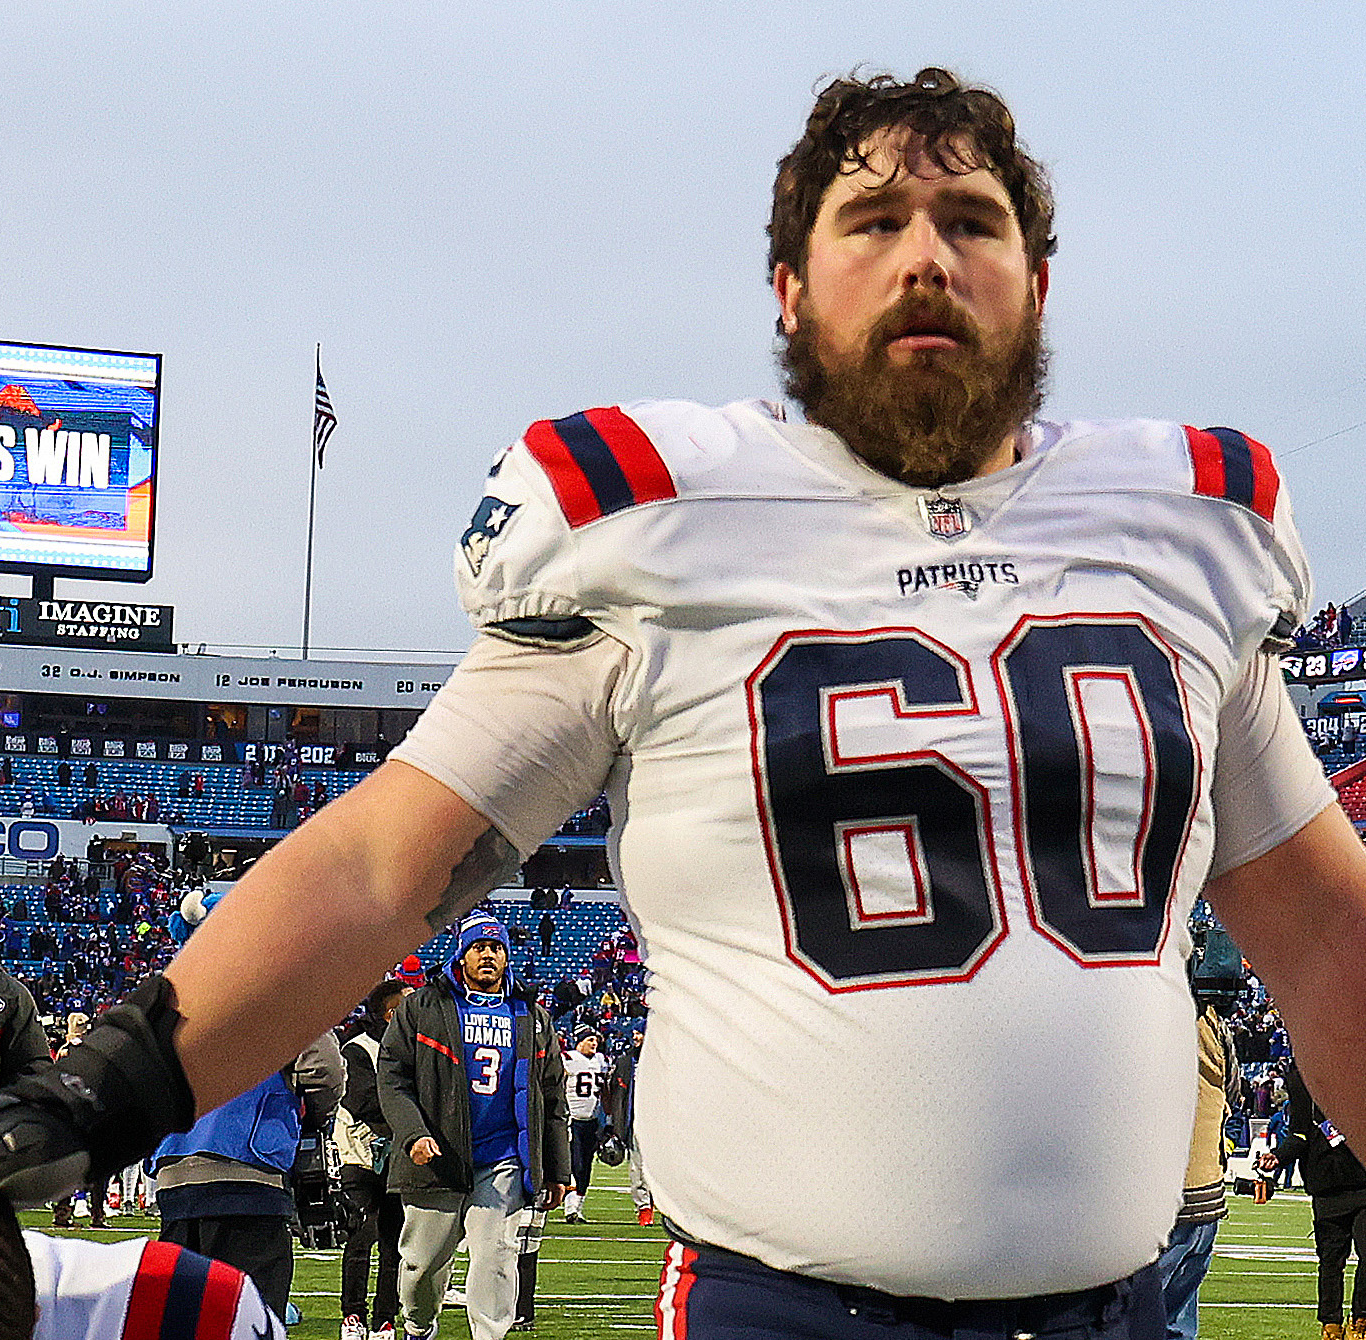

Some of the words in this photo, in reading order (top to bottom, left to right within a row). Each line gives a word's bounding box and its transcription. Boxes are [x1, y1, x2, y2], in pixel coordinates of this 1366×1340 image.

[25, 427, 112, 489] WIN
[897, 562, 1020, 596] PATRIOTS
[39, 602, 160, 625] IMAGINE
[57, 624, 139, 642] STAFFING
[40, 663, 61, 679] 32
[70, 669, 102, 678] O.J.
[110, 671, 180, 682] SIMPSON
[1305, 655, 1326, 676] 23
[215, 673, 231, 688] 12
[238, 677, 269, 686] JOE
[278, 678, 362, 689] FERGUSON
[396, 680, 415, 694] 20
[1306, 715, 1338, 735] 204
[301, 747, 335, 764] 202
[744, 611, 1204, 995] 60
[465, 1014, 489, 1027] LOVE
[491, 1015, 511, 1031] FOR
[464, 1025, 512, 1048] DAMAR
[472, 1048, 502, 1094] 3
